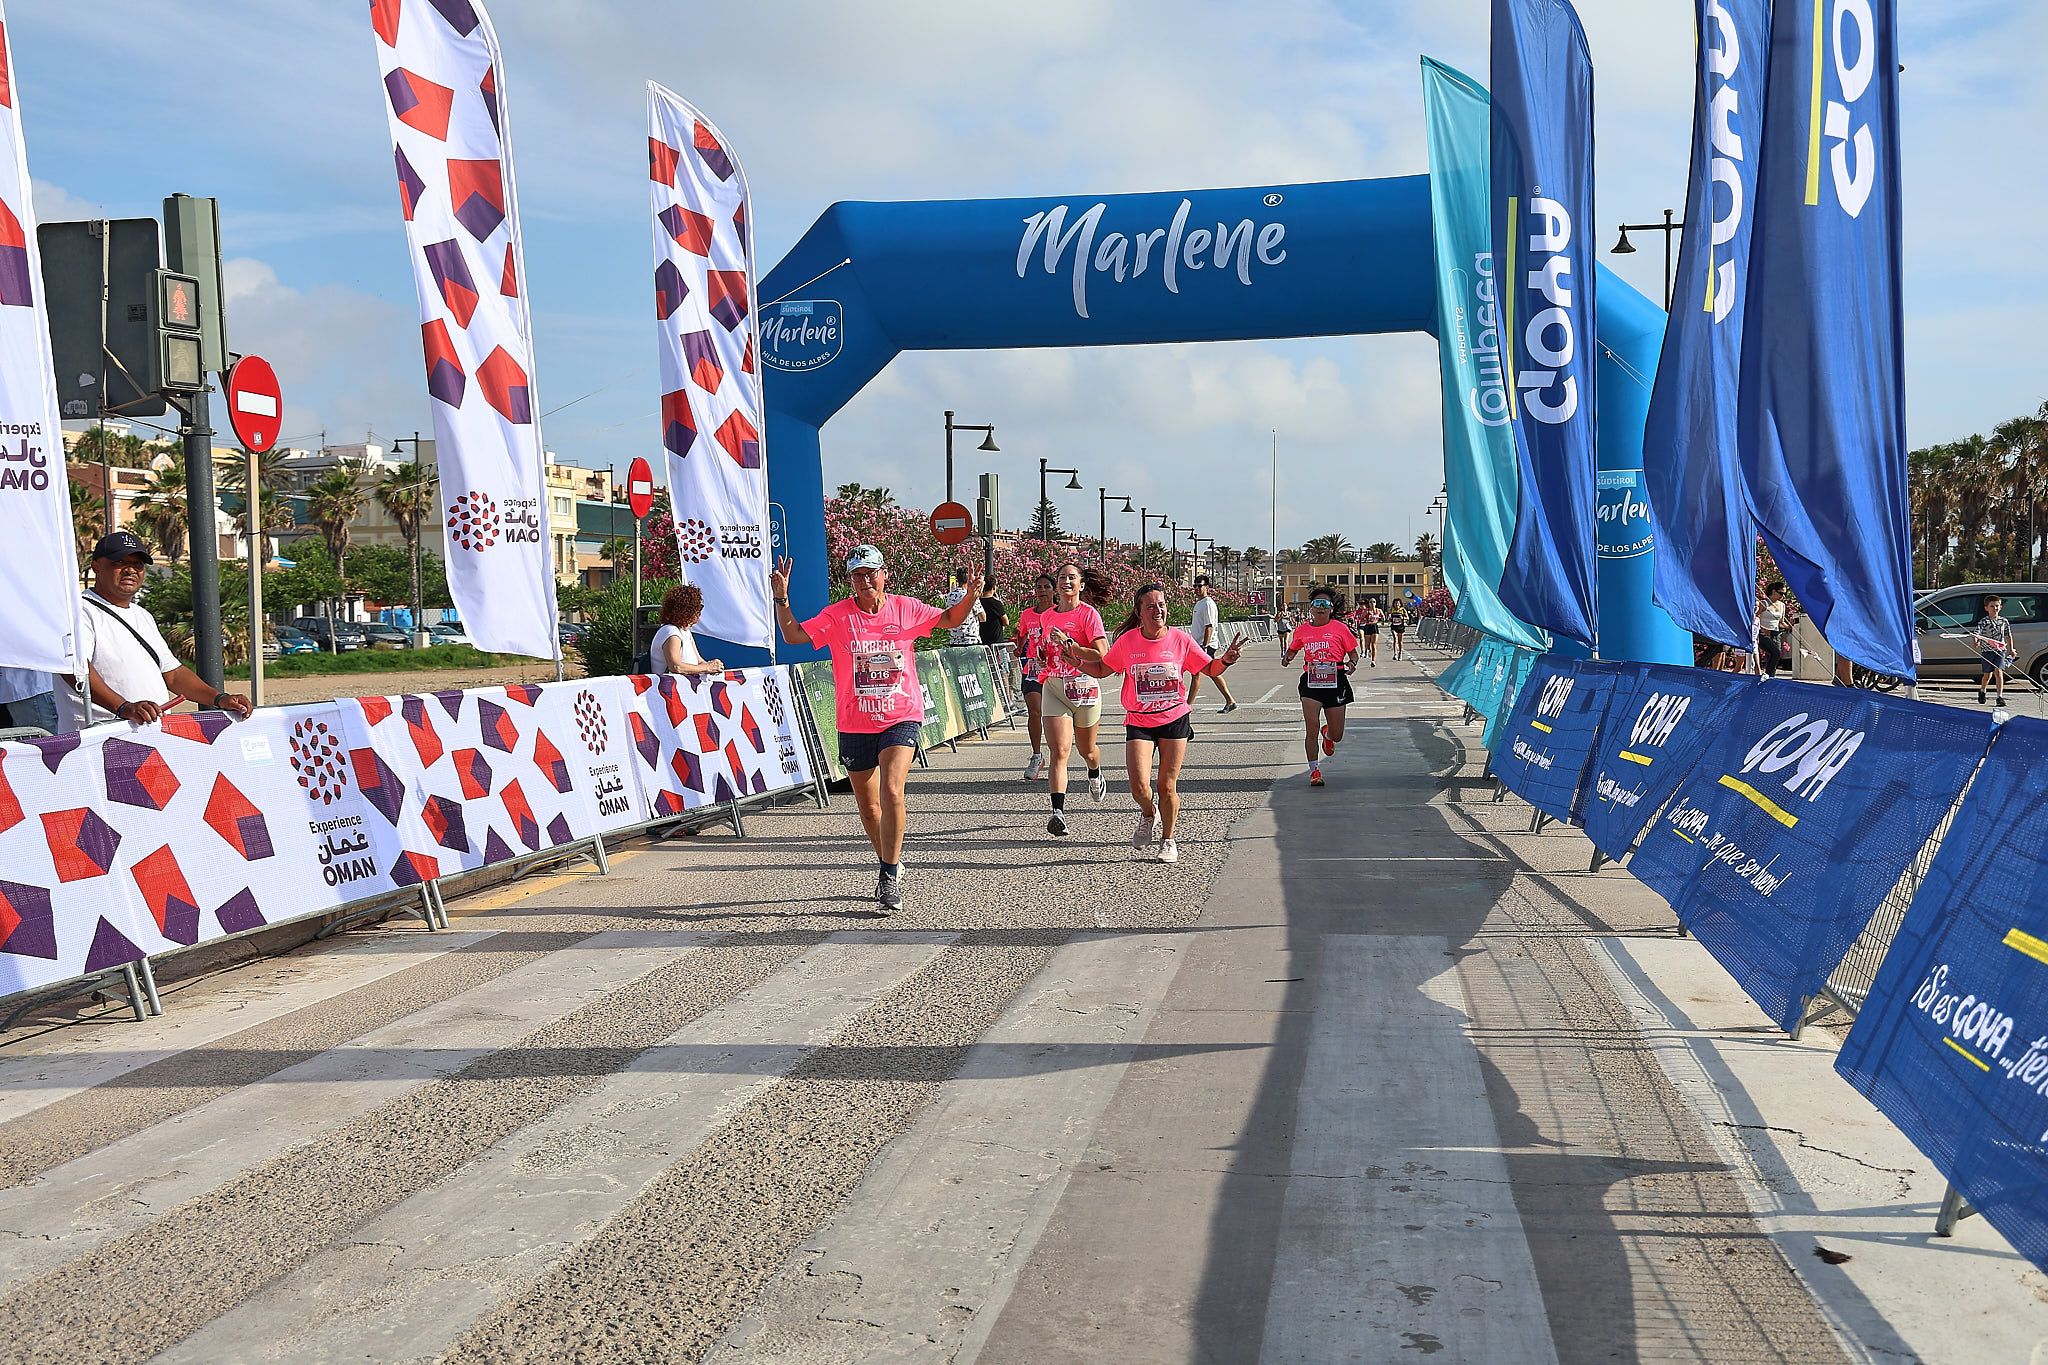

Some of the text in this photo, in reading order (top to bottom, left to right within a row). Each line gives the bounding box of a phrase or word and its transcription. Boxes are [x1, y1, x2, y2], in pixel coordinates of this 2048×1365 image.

[1016, 198, 1287, 318] Marlene
[760, 316, 836, 352] Marlene
[761, 350, 777, 363] HIJA
[780, 359, 790, 367] DE
[809, 351, 831, 366] ALPES
[1597, 489, 1651, 526] arlen
[1597, 544, 1609, 552] DE
[1612, 545, 1630, 553] LOS
[850, 640, 896, 653] CARRERA
[870, 671, 890, 680] 016
[858, 698, 895, 713] MUJER
[1537, 674, 1574, 719] GOYA
[1629, 692, 1691, 747] GOYA
[1739, 712, 1865, 803] GOYA
[599, 795, 630, 817] OMAN
[309, 815, 362, 835] Experience
[1678, 807, 1710, 837] GOYA
[1702, 842, 1746, 871] que
[1734, 858, 1761, 878] ser
[323, 856, 377, 886] OMAN
[1932, 994, 1959, 1025] es
[1952, 994, 2013, 1058] GOYA
